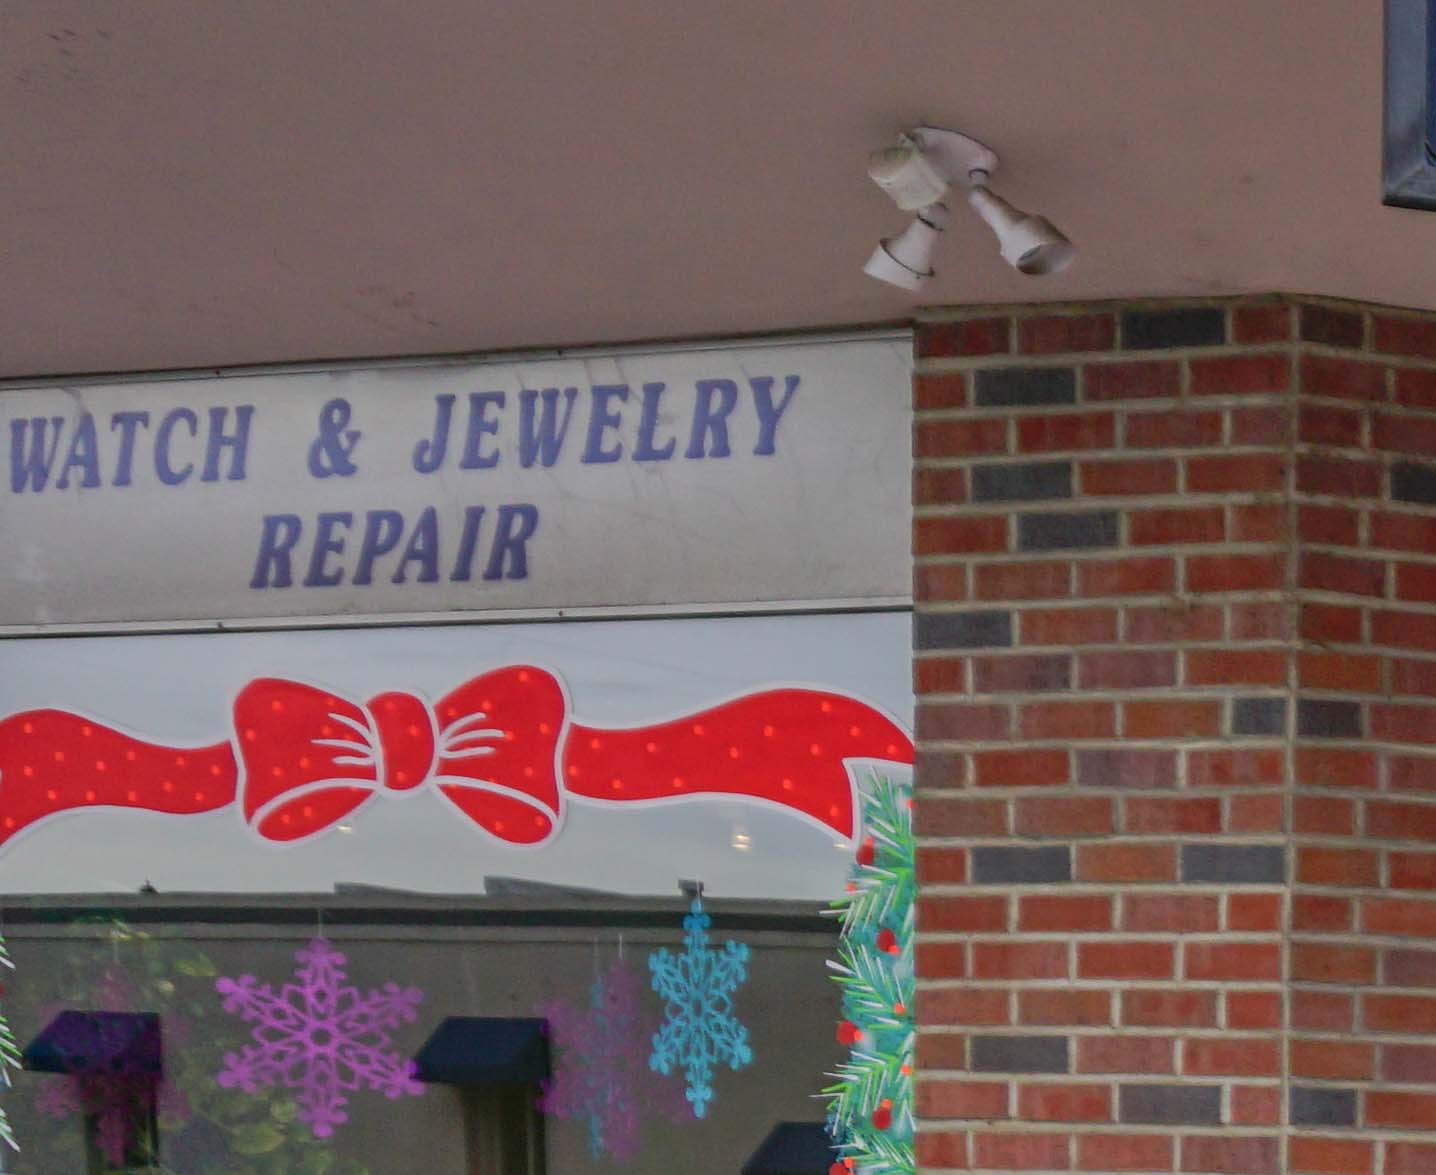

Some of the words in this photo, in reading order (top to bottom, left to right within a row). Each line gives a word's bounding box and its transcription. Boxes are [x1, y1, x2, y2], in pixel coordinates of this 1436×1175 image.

[8, 403, 255, 494] WATCH
[308, 398, 363, 479] &
[412, 373, 801, 475] JEWELRY
[249, 502, 540, 591] REPAIR
